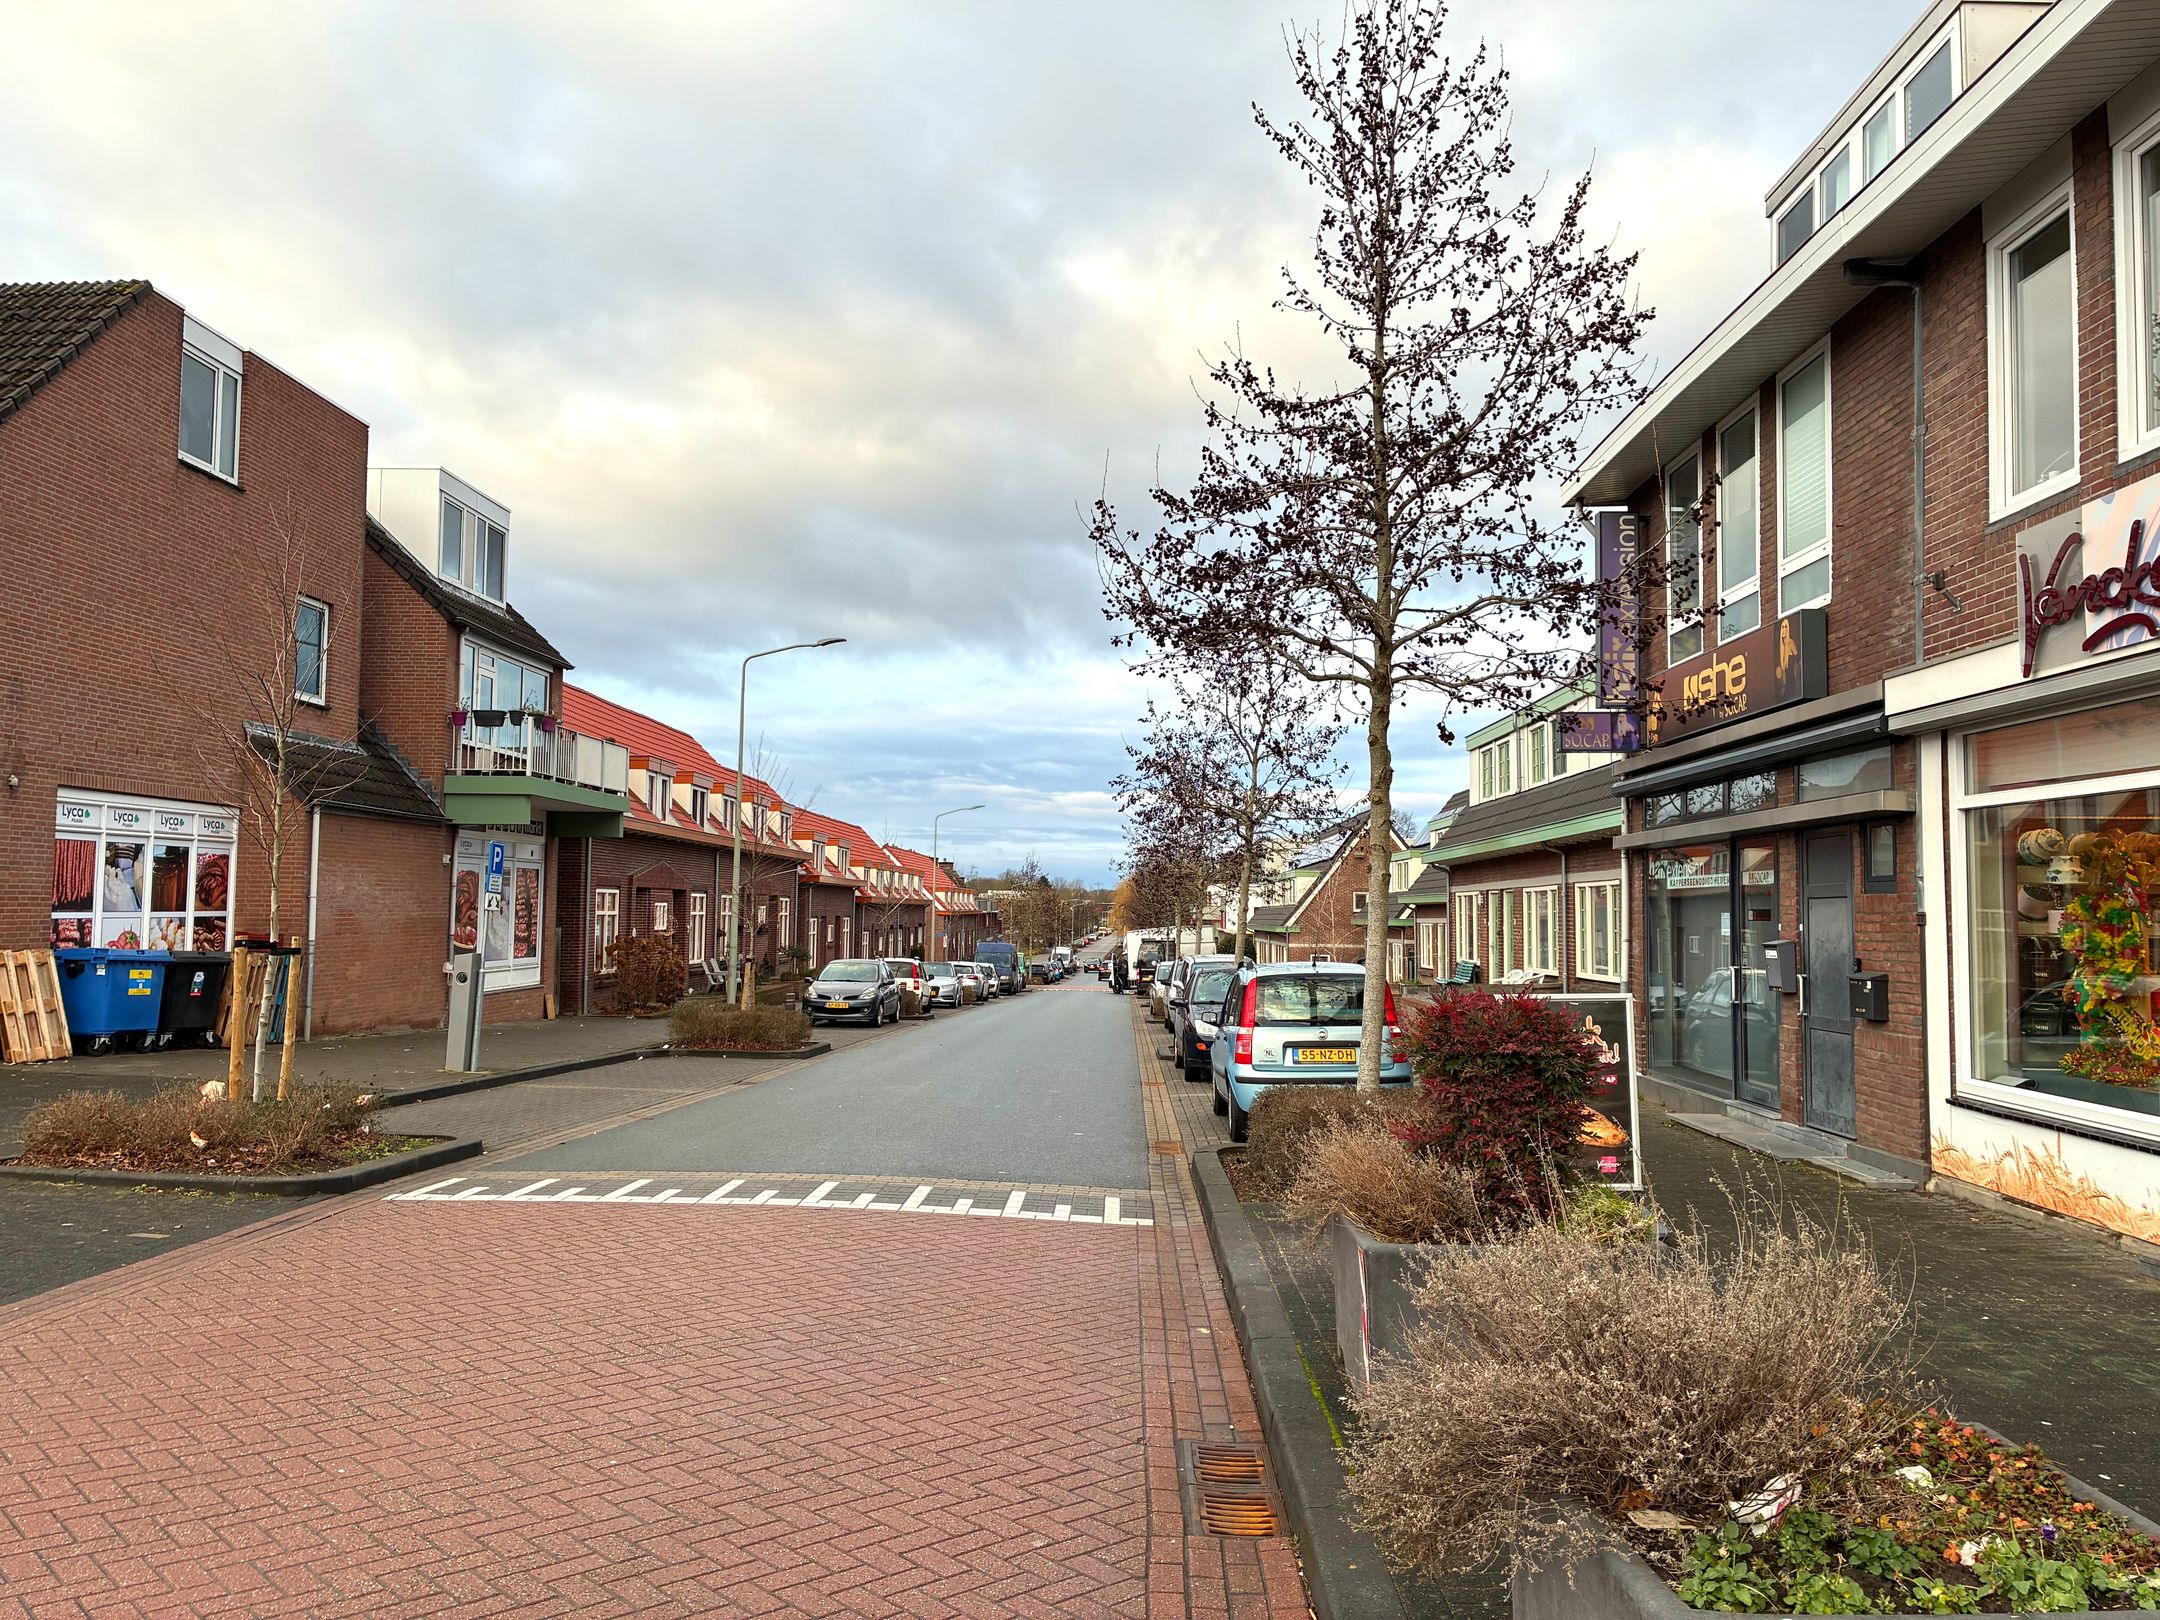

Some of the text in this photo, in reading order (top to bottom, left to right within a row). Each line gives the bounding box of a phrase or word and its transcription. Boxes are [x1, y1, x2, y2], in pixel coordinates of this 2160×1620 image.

[1604, 637, 1636, 703] hair
[1698, 653, 1747, 706] she
[62, 804, 83, 819] Lyca
[113, 810, 133, 823] Lyca
[160, 814, 179, 827] Lyca
[203, 818, 220, 830] Lyca
[493, 846, 502, 871] P
[1301, 1050, 1353, 1060] 55-NZ-DH
